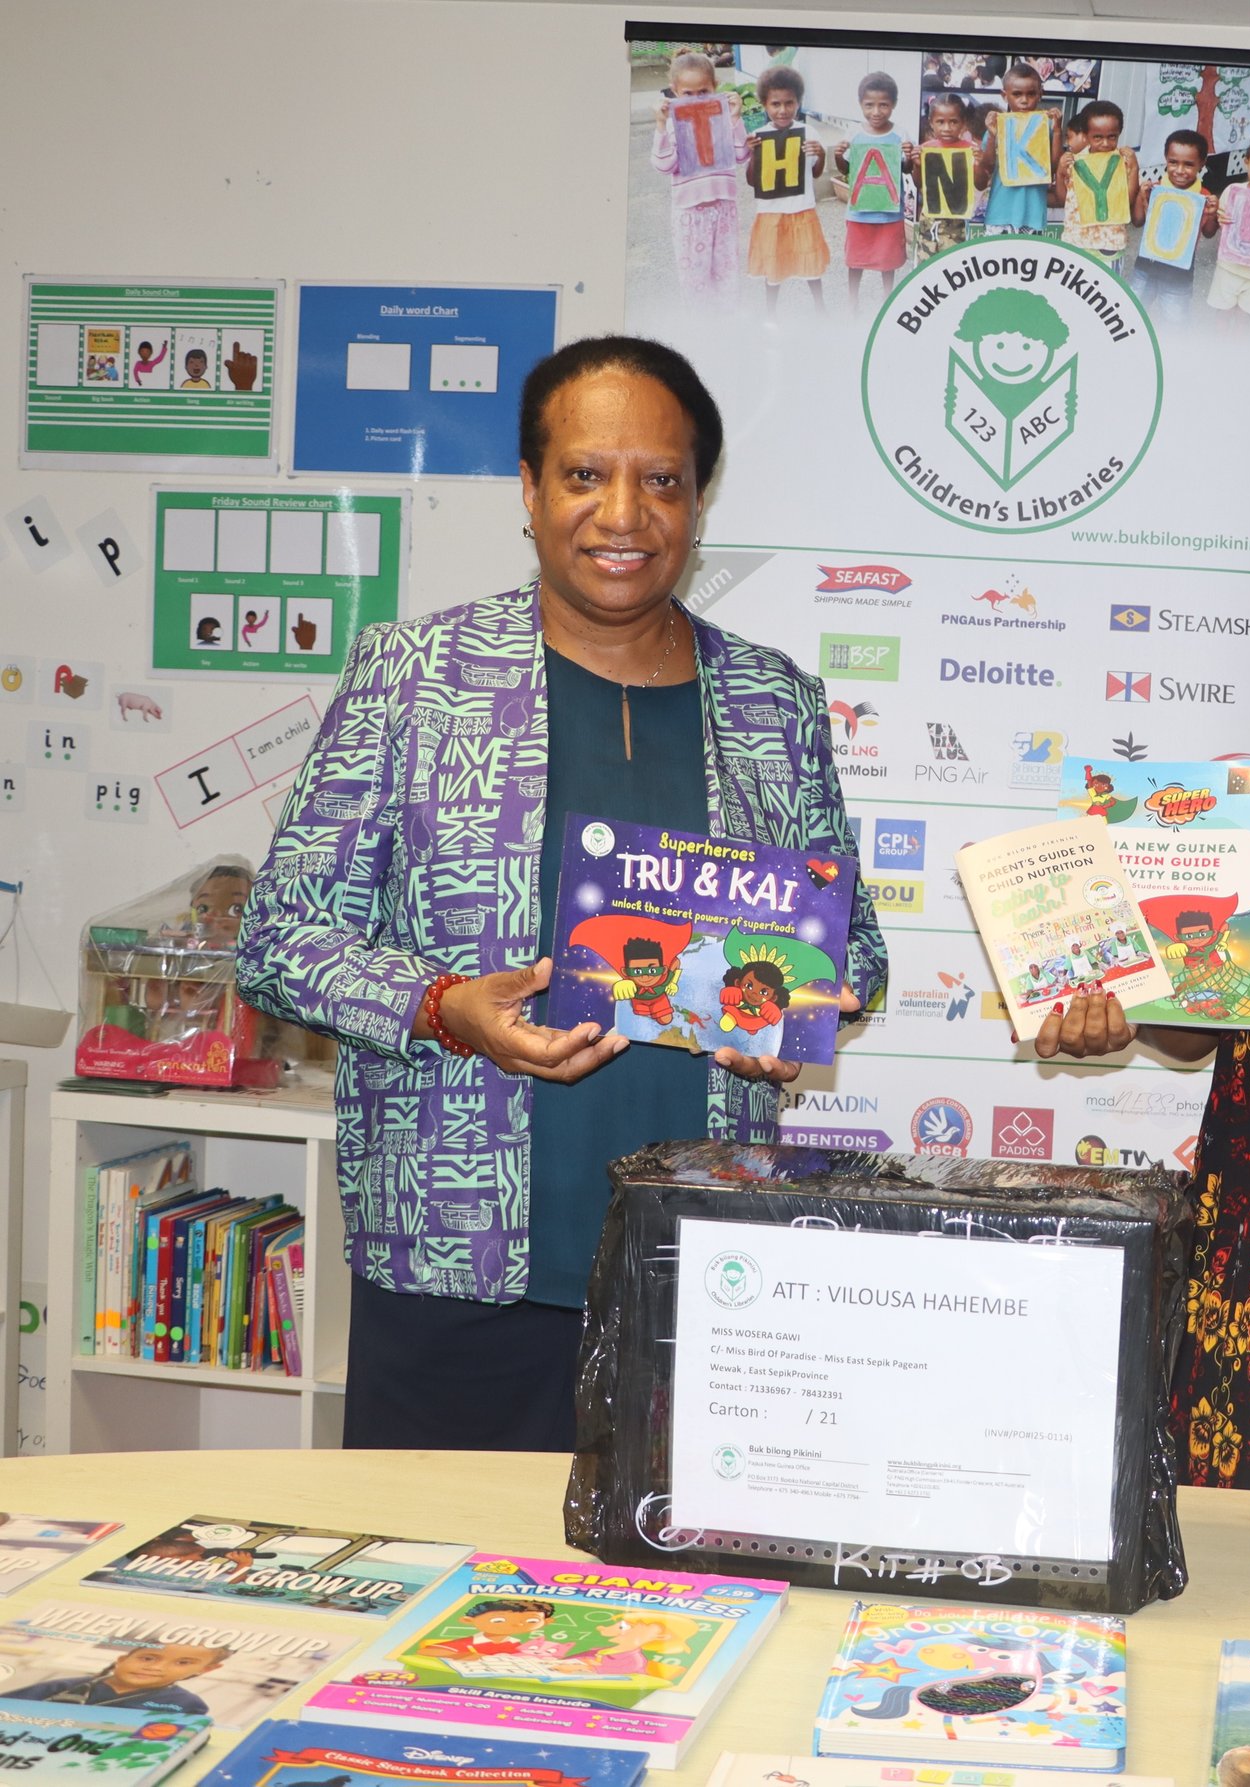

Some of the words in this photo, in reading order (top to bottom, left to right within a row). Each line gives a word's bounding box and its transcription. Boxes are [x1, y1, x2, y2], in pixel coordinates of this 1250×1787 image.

[897, 283, 949, 335] Buk
[943, 256, 1038, 291] bilong
[1044, 256, 1136, 343] Pikinini
[380, 305, 403, 316] Daily
[406, 305, 430, 315] word
[432, 306, 459, 316] Chart
[963, 407, 997, 443] 123
[1018, 406, 1060, 445] ABC
[894, 444, 1009, 522] Children's
[1017, 455, 1124, 522] Libraries
[212, 497, 240, 507] Friday
[241, 498, 271, 507] Sound
[272, 498, 306, 507] Review
[308, 499, 333, 507] chart
[835, 570, 900, 586] SEAFAST
[814, 595, 853, 605] SHIPPING
[855, 597, 880, 606] MADE
[881, 599, 912, 608] SIMPLE
[941, 614, 992, 627] PNGAus
[994, 616, 1066, 631] Partnership
[850, 645, 890, 666] BSP
[851, 745, 879, 757] LNG
[915, 764, 958, 783] PNG
[962, 766, 989, 785] Air
[1162, 788, 1211, 806] SUPER
[1162, 796, 1217, 817] HERO
[659, 831, 756, 863] Superheroes
[878, 832, 911, 850] CPL
[1136, 842, 1170, 853] NEW
[1176, 843, 1238, 854] GUINEA
[979, 858, 1035, 882] PARENT'S
[1038, 847, 1077, 863] GUIDE
[1080, 843, 1095, 854] TO
[1171, 856, 1220, 867] GUIDE
[616, 853, 684, 893] TRU
[694, 861, 719, 898] &
[728, 867, 798, 912] KAI
[987, 875, 1024, 893] CHILD
[1027, 857, 1094, 880] NUTRITION
[1132, 882, 1170, 891] Students
[1182, 885, 1219, 893] Families
[612, 897, 643, 912] unlock
[644, 901, 661, 914] the
[661, 906, 693, 920] secret
[694, 912, 729, 926] powers
[731, 915, 743, 928] of
[743, 918, 796, 935] superfoods
[899, 998, 946, 1009] volunteers
[902, 989, 949, 999] australian
[895, 1008, 943, 1018] international
[794, 1093, 878, 1113] PALADIN
[797, 1133, 878, 1148] DENTONS
[920, 1144, 962, 1157] NGCB
[999, 1145, 1045, 1156] PADDYS
[159, 1277, 168, 1300] Thank
[172, 1277, 184, 1299] Sorry
[157, 1301, 166, 1316] you
[772, 1281, 810, 1300] ATT
[827, 1285, 916, 1309] VILOUSA
[923, 1292, 1028, 1317] HAHEMBE
[711, 1327, 733, 1336] MISS
[735, 1329, 773, 1340] WOSERA
[775, 1332, 800, 1342] GAWI
[726, 1346, 746, 1356] Miss
[748, 1347, 765, 1357] Bird
[767, 1349, 778, 1358] Of
[780, 1350, 816, 1361] Paradise
[824, 1354, 844, 1364] Miss
[846, 1356, 865, 1366] East
[866, 1357, 890, 1368] Sepik
[892, 1359, 928, 1370] Pageant
[709, 1381, 742, 1391] Contact
[749, 1384, 791, 1395] 71336967
[801, 1388, 843, 1400] 78432391
[709, 1402, 759, 1419] Carton
[820, 1410, 838, 1425] 21
[749, 1445, 764, 1454] Buk
[766, 1446, 791, 1458] bilong
[793, 1447, 822, 1458] Pikinini
[552, 1571, 696, 1596] GIANT
[470, 1583, 588, 1600] MATHS
[588, 1586, 751, 1620] READINESS
[485, 1689, 530, 1703] Areas
[533, 1694, 592, 1709] Include
[325, 1750, 375, 1768] Classic
[376, 1757, 448, 1778] Storybook
[455, 1768, 532, 1779] Collection
